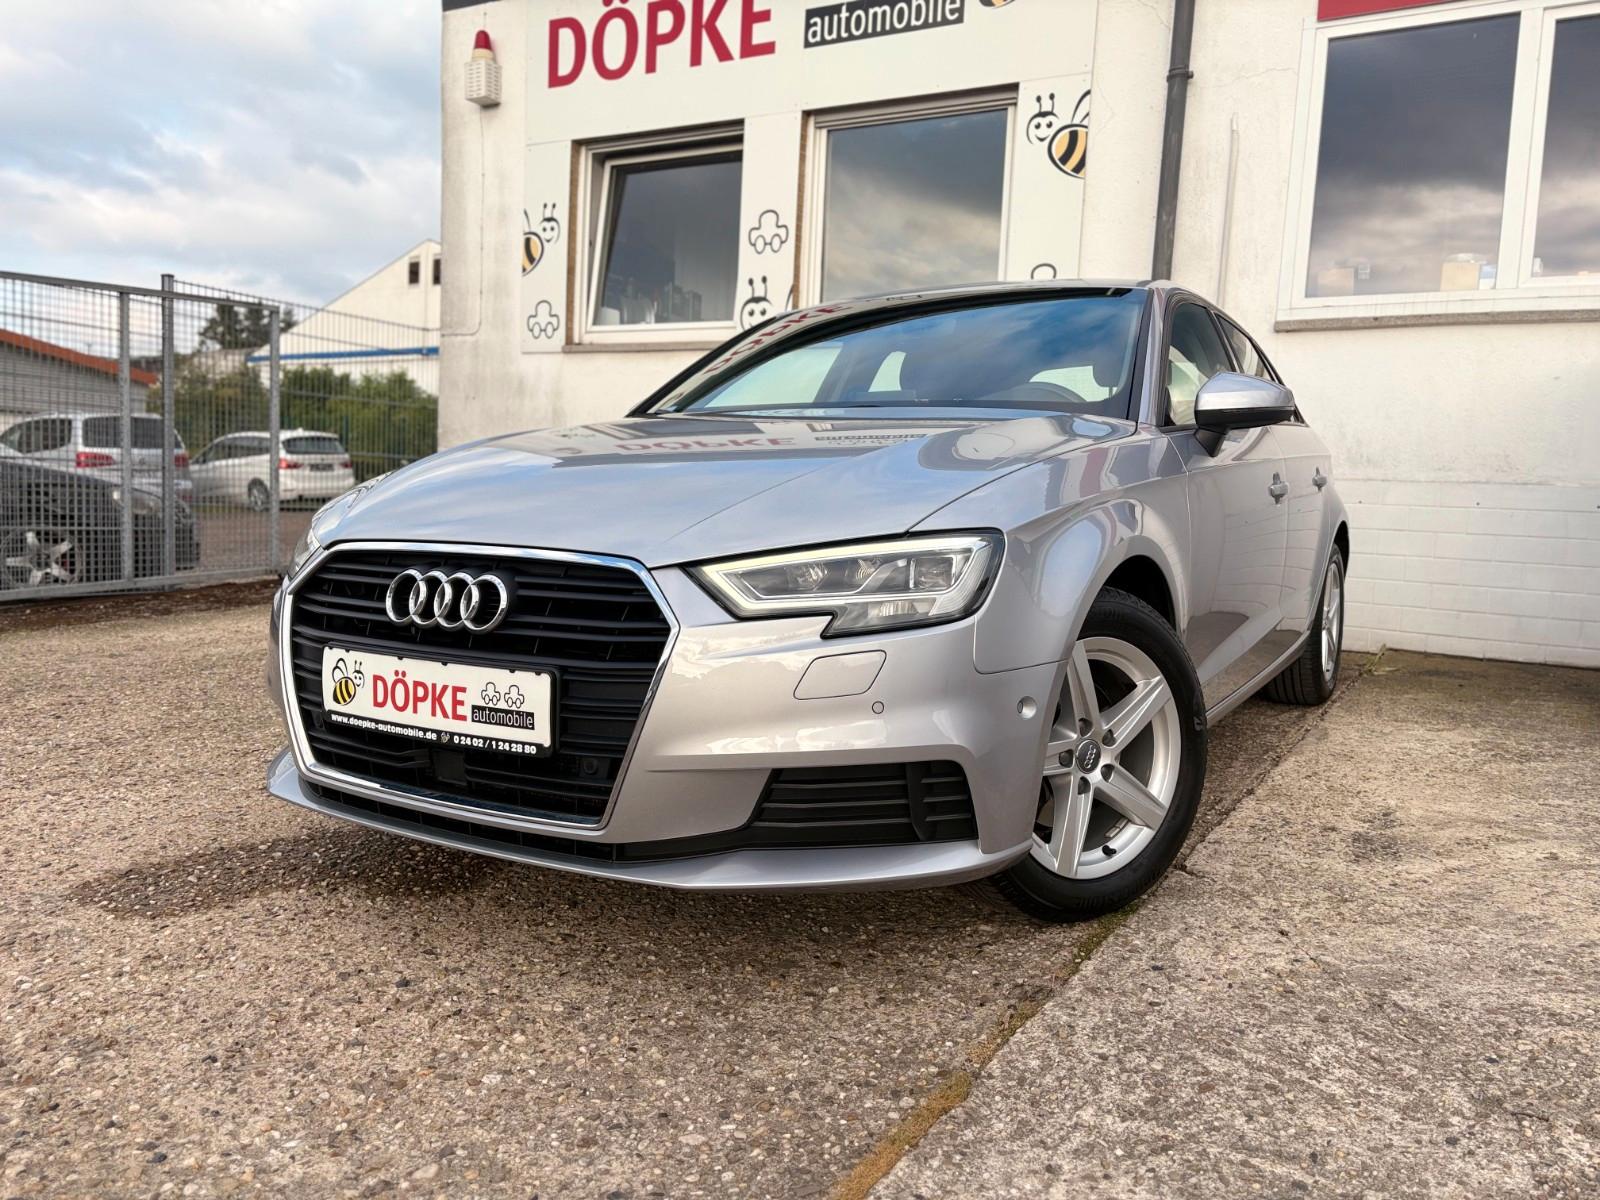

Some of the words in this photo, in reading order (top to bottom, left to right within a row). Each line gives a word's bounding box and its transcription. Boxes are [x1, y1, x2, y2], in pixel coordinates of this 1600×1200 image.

[807, 0, 961, 43] automobile
[548, 0, 776, 88] DÖPKE
[372, 669, 468, 721] DÖPKE
[330, 713, 438, 740] www.doepke-automobile.de
[473, 708, 533, 728] automobile
